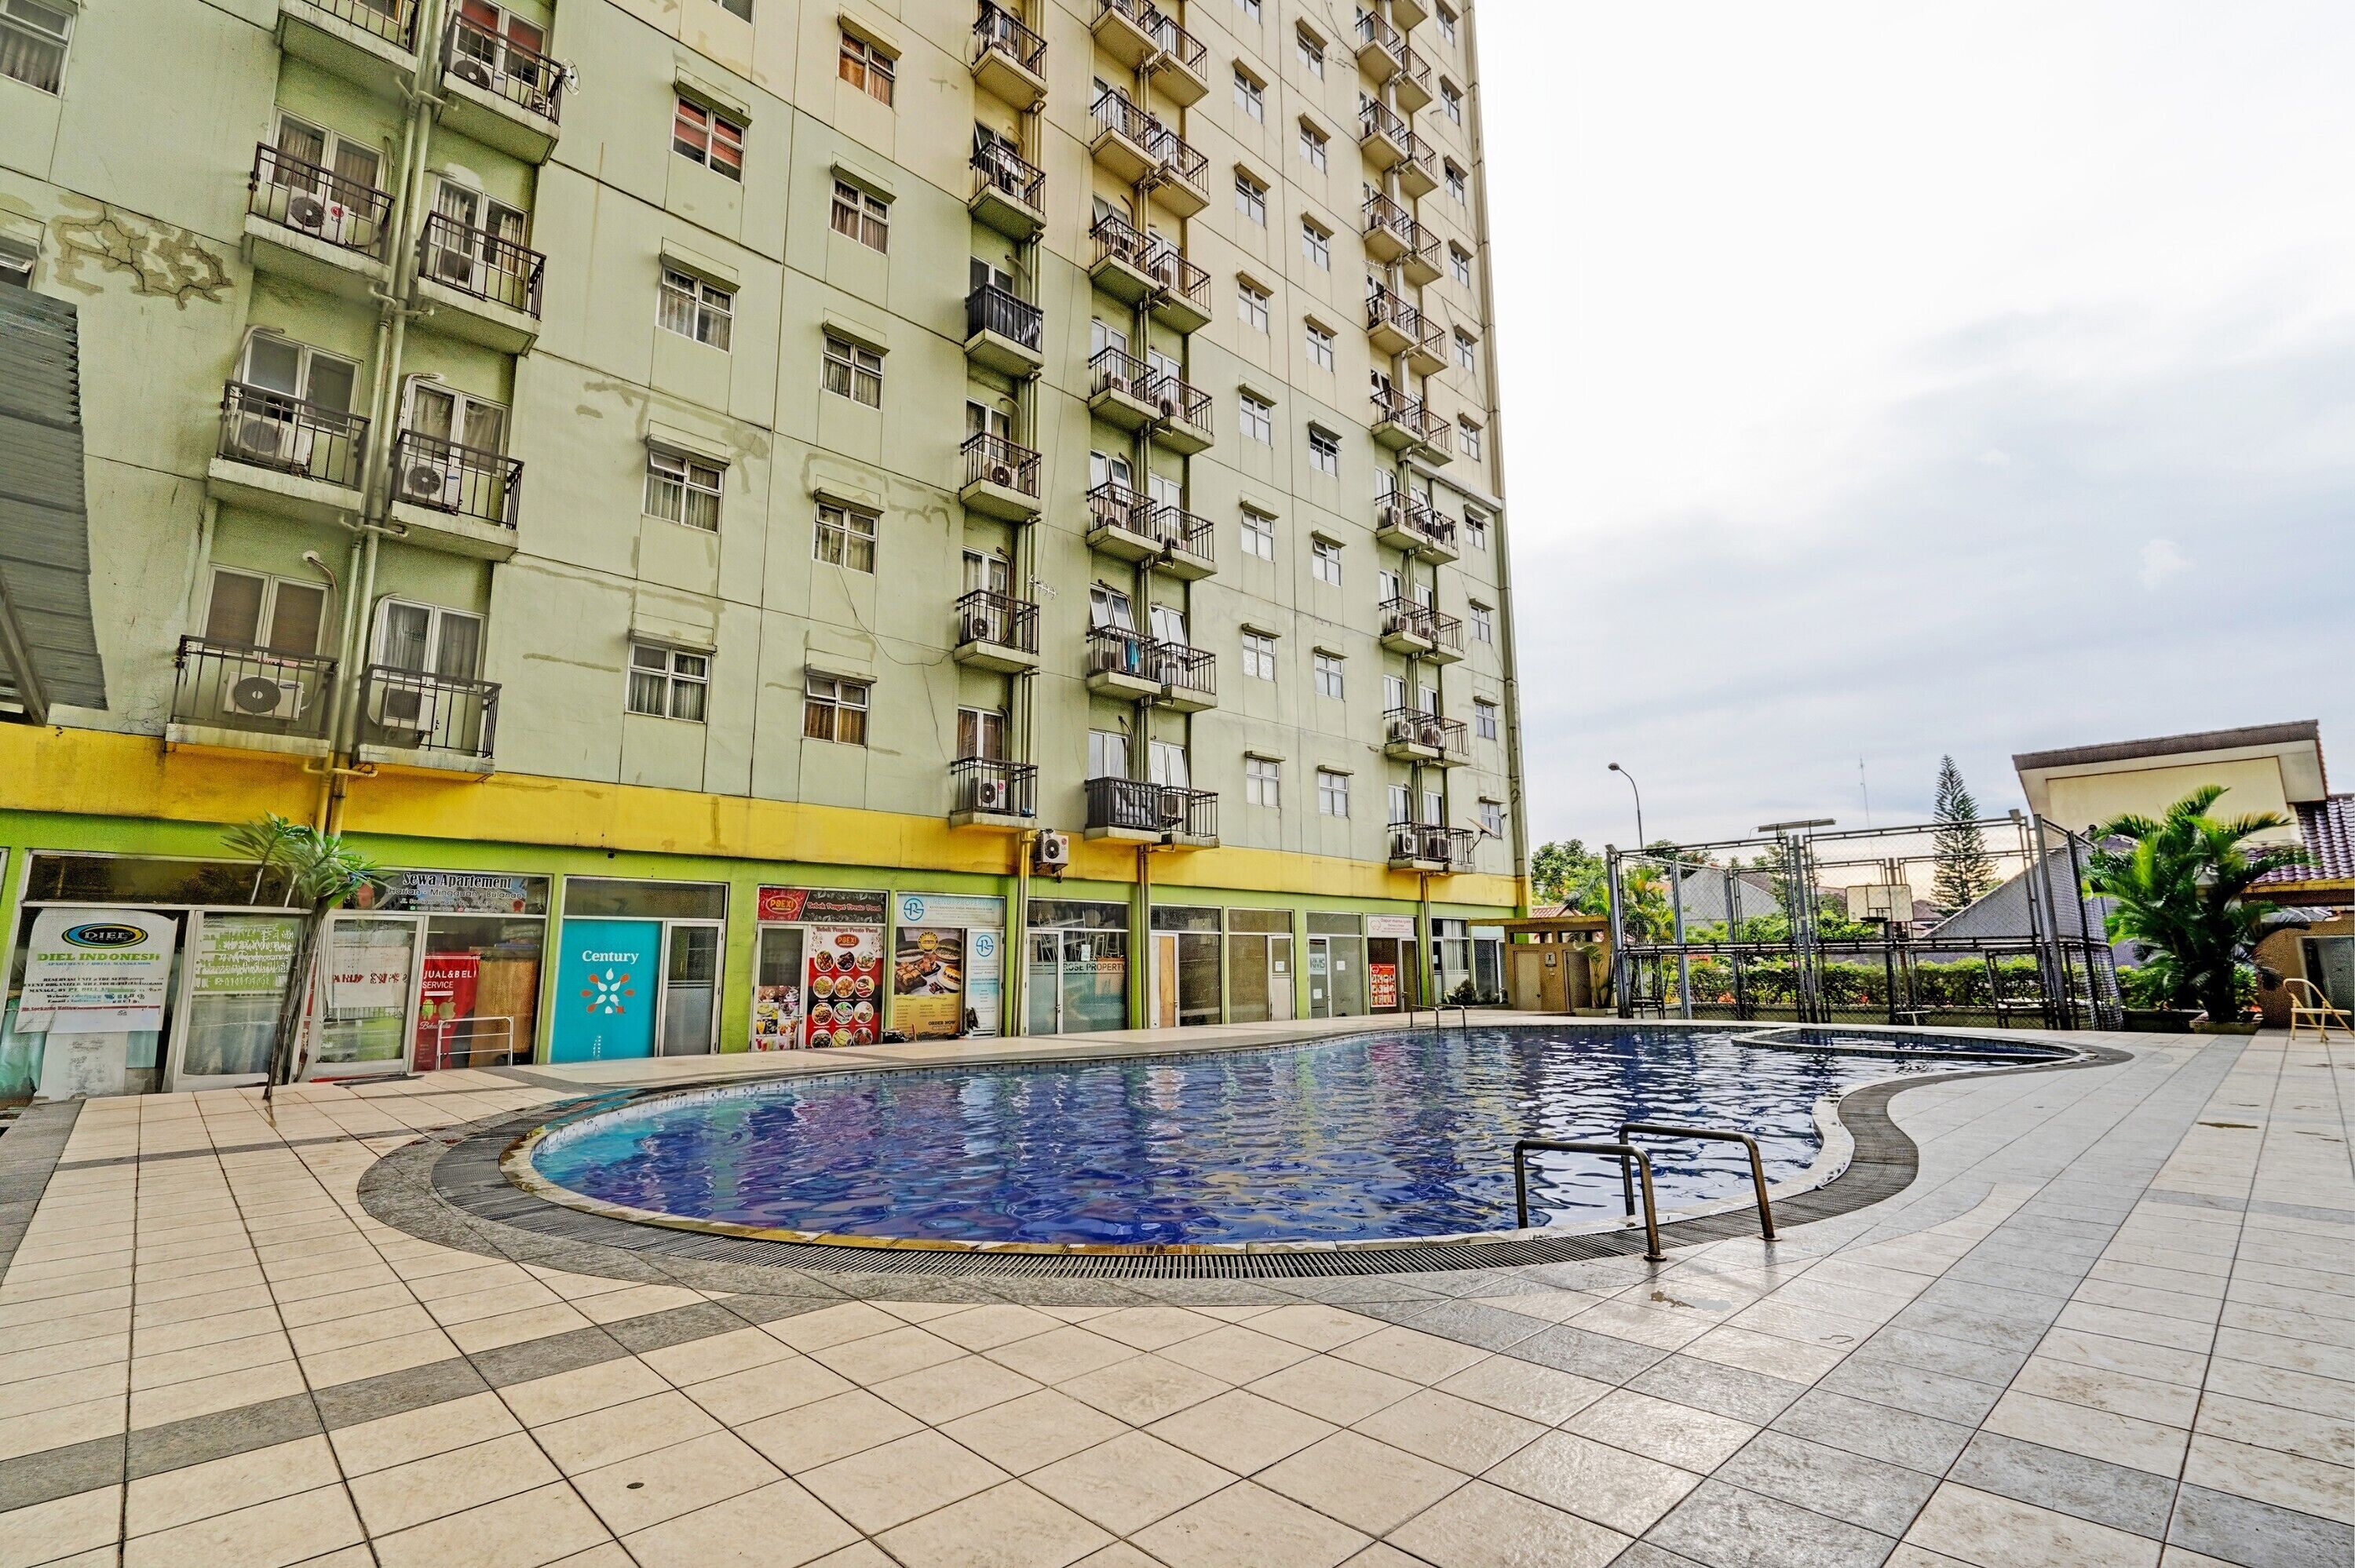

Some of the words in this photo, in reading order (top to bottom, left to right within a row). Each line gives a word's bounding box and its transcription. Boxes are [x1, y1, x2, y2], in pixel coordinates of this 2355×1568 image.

[403, 872, 436, 886] Sewa
[440, 873, 512, 888] Apartement
[389, 887, 421, 895] Harian
[429, 888, 477, 899] Mingguan
[38, 953, 75, 961] DIEL
[582, 950, 639, 965] Century
[1063, 963, 1083, 972] ROSE
